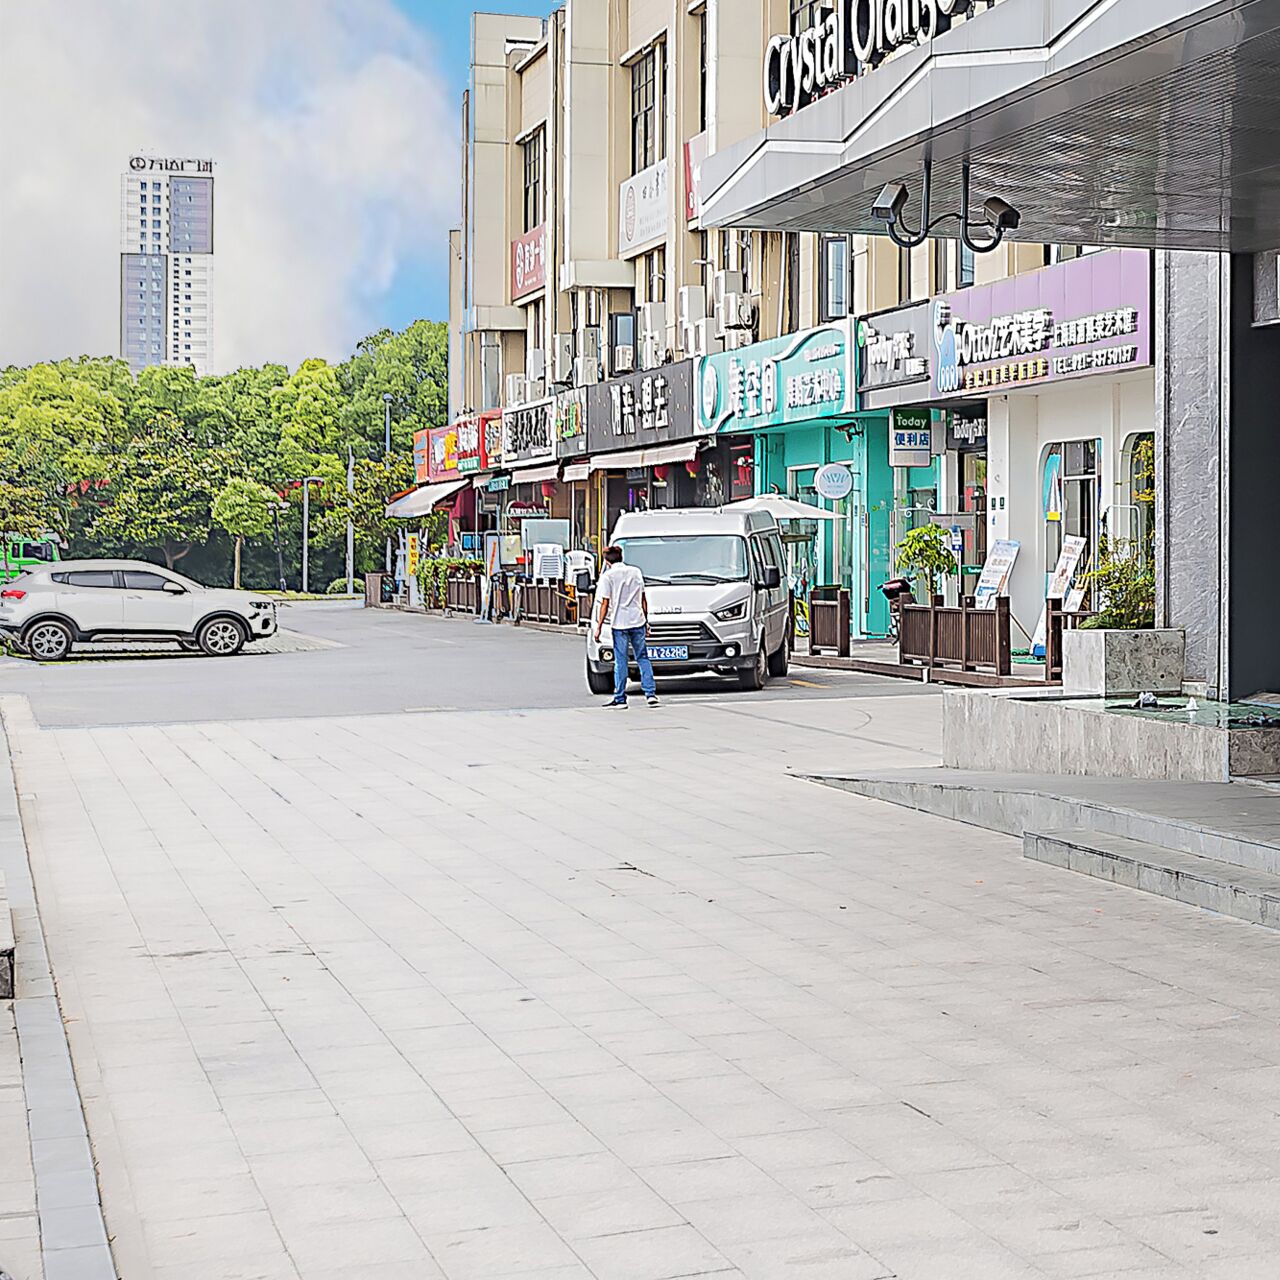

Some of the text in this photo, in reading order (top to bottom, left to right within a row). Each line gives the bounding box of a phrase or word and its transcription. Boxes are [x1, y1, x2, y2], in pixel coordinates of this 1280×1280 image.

[896, 414, 927, 428] Today
[895, 432, 929, 446] 便利店
